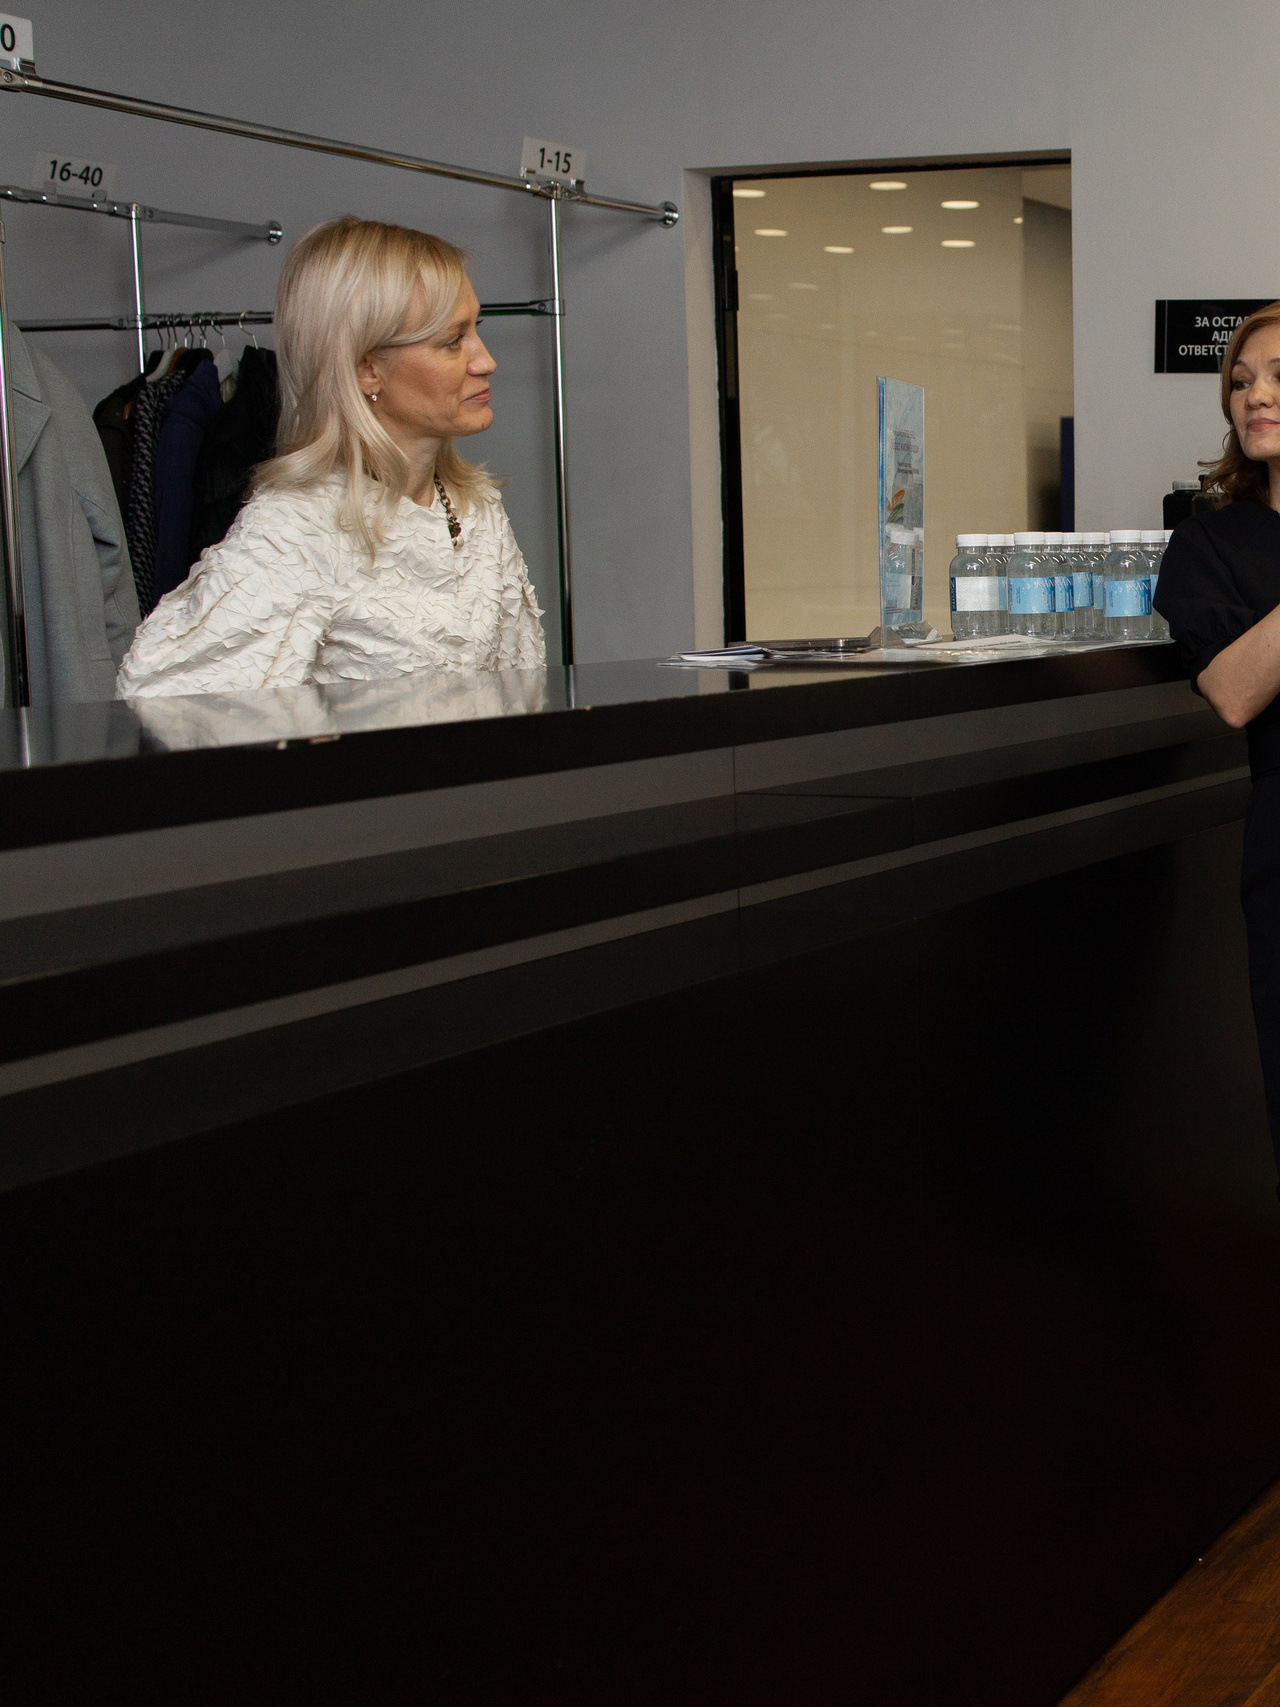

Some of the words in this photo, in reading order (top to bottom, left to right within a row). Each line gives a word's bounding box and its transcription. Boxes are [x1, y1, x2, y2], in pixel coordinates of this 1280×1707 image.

[50, 159, 104, 187] 16-40
[539, 147, 572, 174] 1-15
[1194, 316, 1210, 328] ЗА
[1212, 316, 1250, 328] ОСТА
